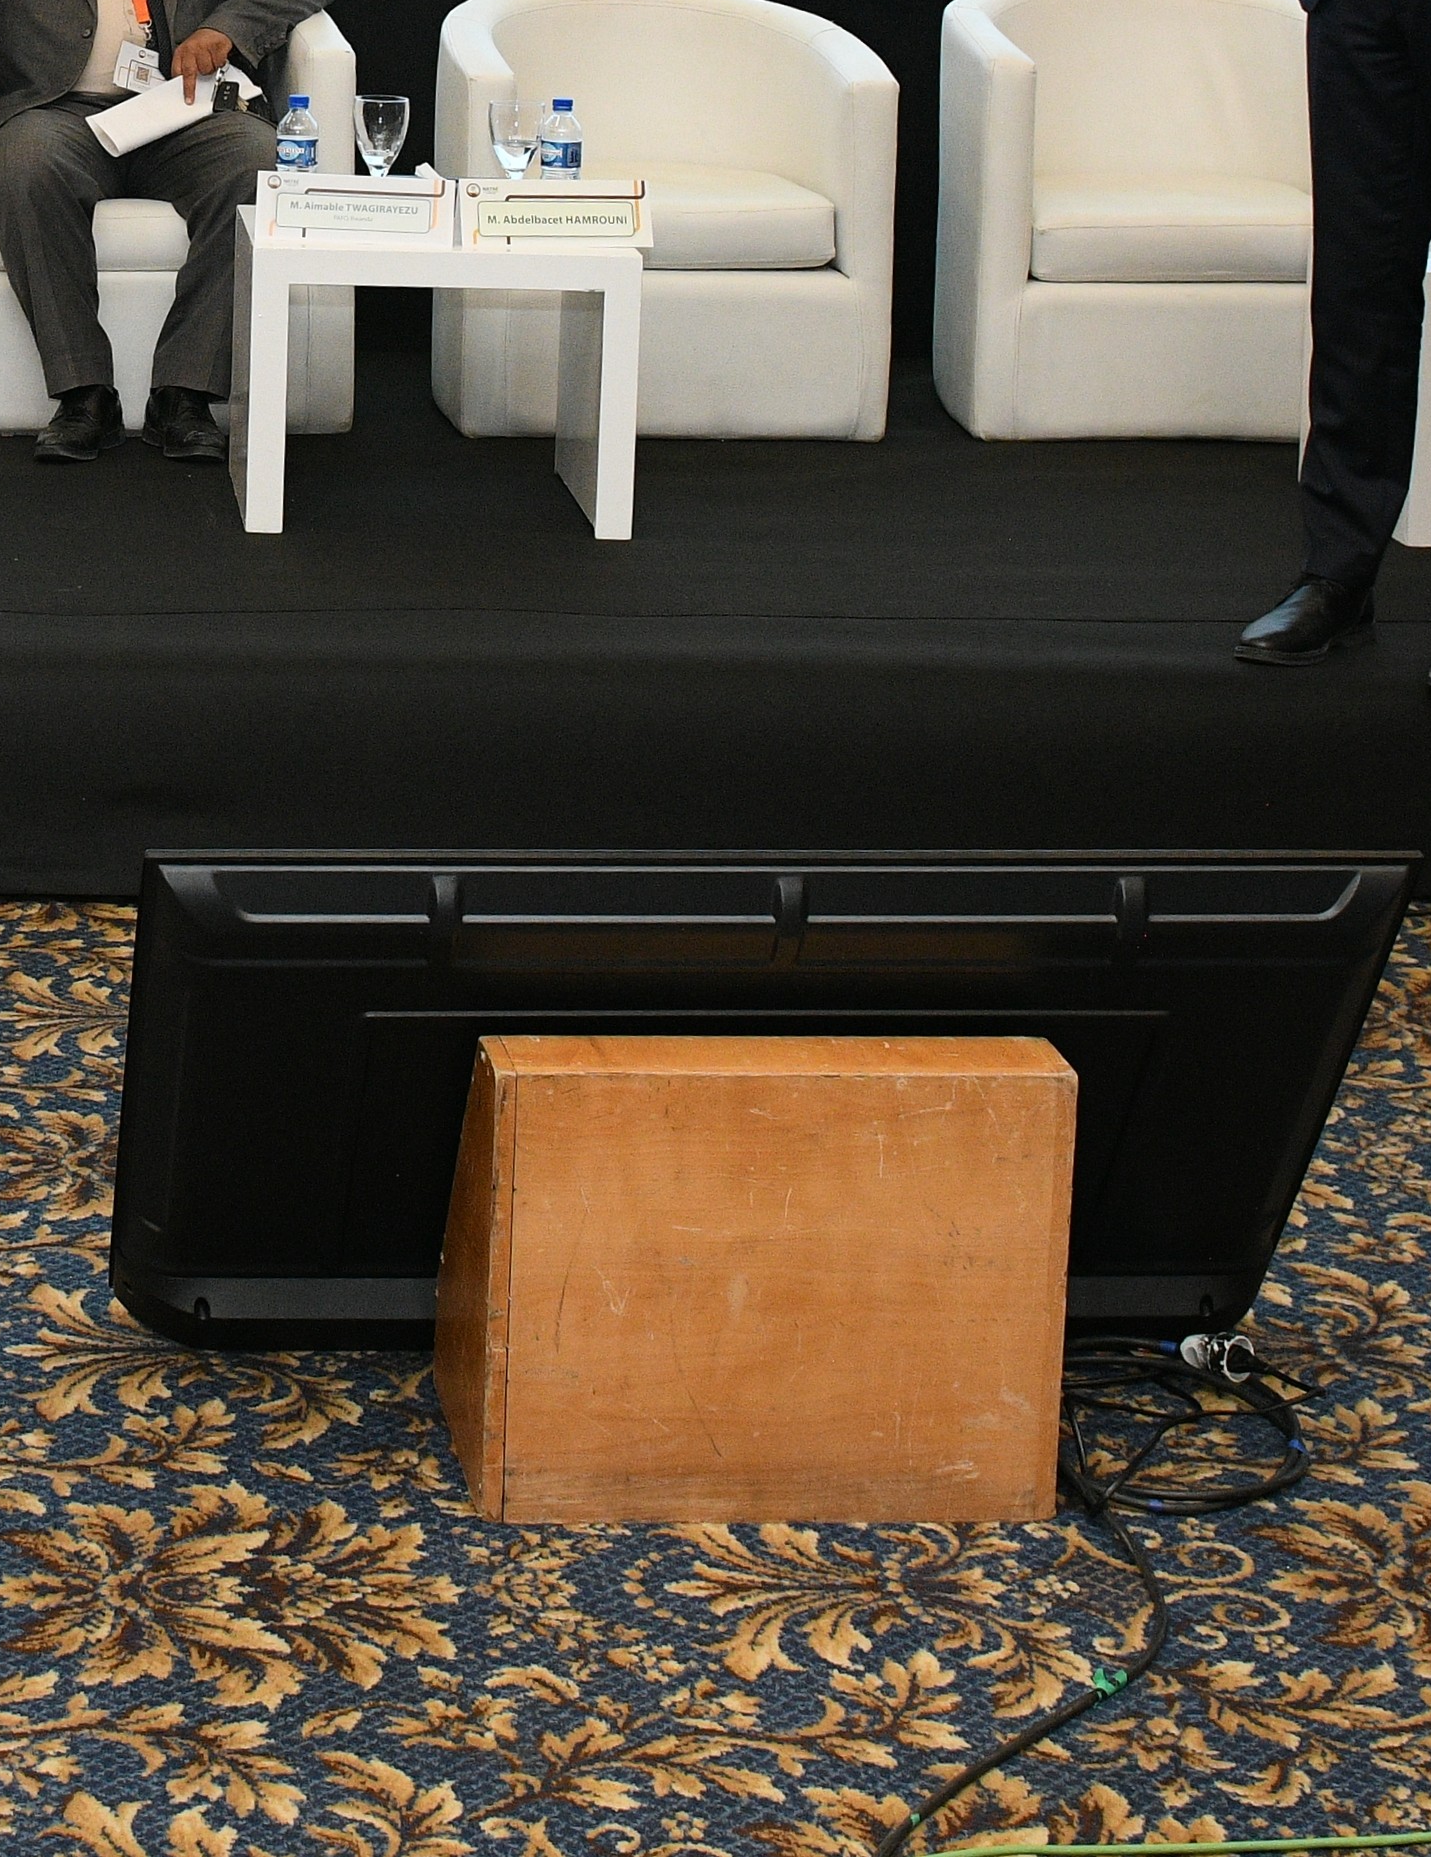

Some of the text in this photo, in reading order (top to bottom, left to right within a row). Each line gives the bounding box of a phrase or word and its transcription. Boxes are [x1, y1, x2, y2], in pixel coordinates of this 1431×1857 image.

[304, 201, 344, 212] Aimable
[487, 215, 628, 225] M. Abdelbacet HAMROUNI
